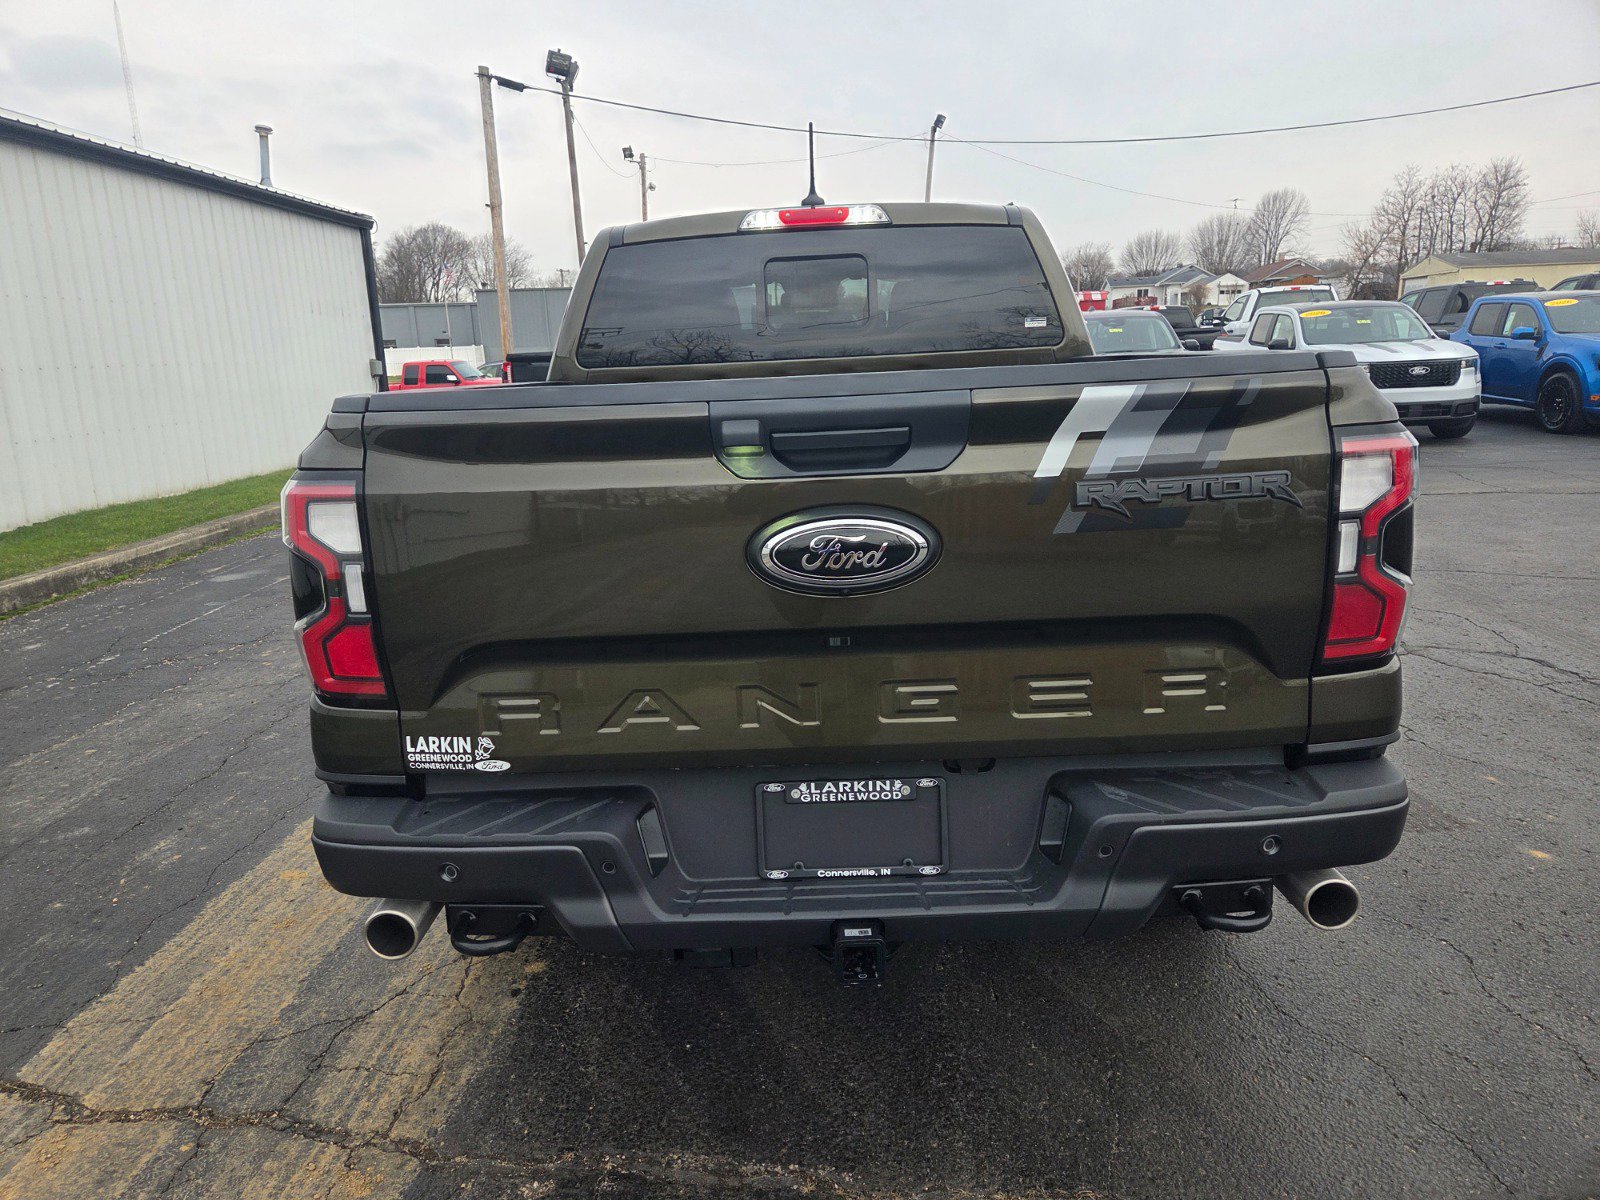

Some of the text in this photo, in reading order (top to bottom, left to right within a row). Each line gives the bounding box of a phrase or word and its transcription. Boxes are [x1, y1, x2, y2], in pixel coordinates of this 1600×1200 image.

[1075, 470, 1303, 518] RAPTOR
[802, 534, 888, 571] Ford
[478, 667, 1230, 736] RANGER
[405, 735, 472, 753] LARKIN
[407, 753, 473, 762] GREENEWOOD
[409, 762, 475, 770] CONNERSVILLE, IN
[482, 761, 504, 770] Ford
[811, 780, 890, 794] LARKIN
[919, 779, 936, 787] Ford
[800, 791, 902, 802] GREENEWOOD
[817, 869, 878, 877] Connersville,
